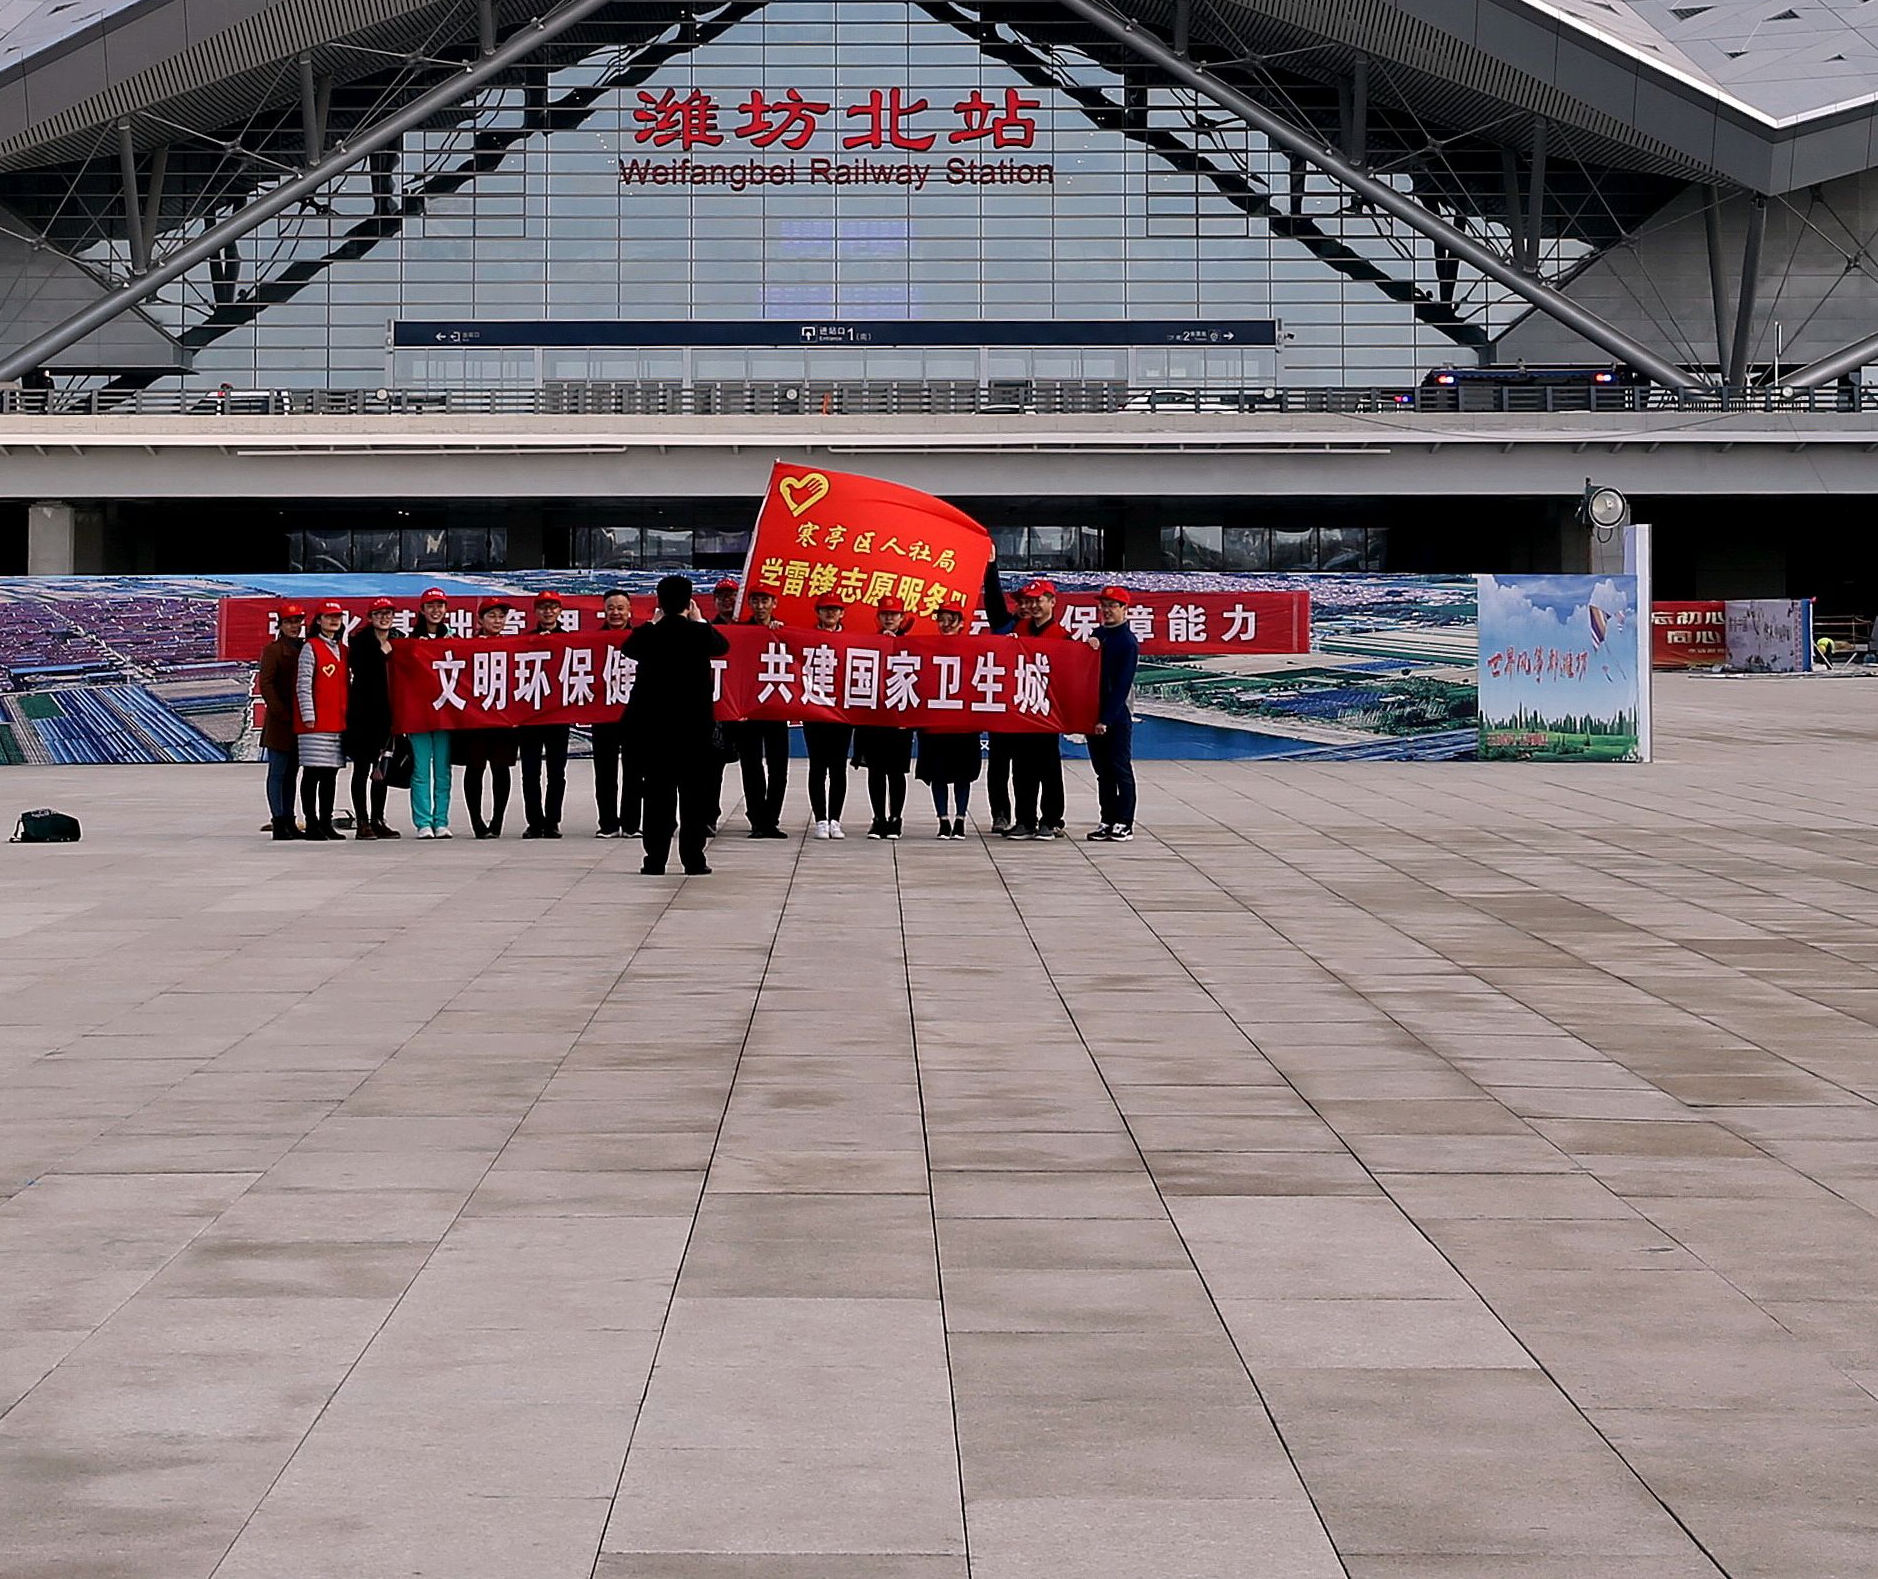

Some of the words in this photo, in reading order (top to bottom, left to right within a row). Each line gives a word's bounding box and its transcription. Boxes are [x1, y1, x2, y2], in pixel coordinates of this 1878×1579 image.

[633, 87, 1041, 150] 潍坊北站
[619, 158, 796, 191] Weifangbei
[810, 158, 930, 190] Railway
[945, 158, 1054, 185] Station
[794, 520, 957, 574] 寒亭区人社局
[431, 641, 727, 712] 文明环保健
[757, 642, 1052, 717] 共建国家卫生城
